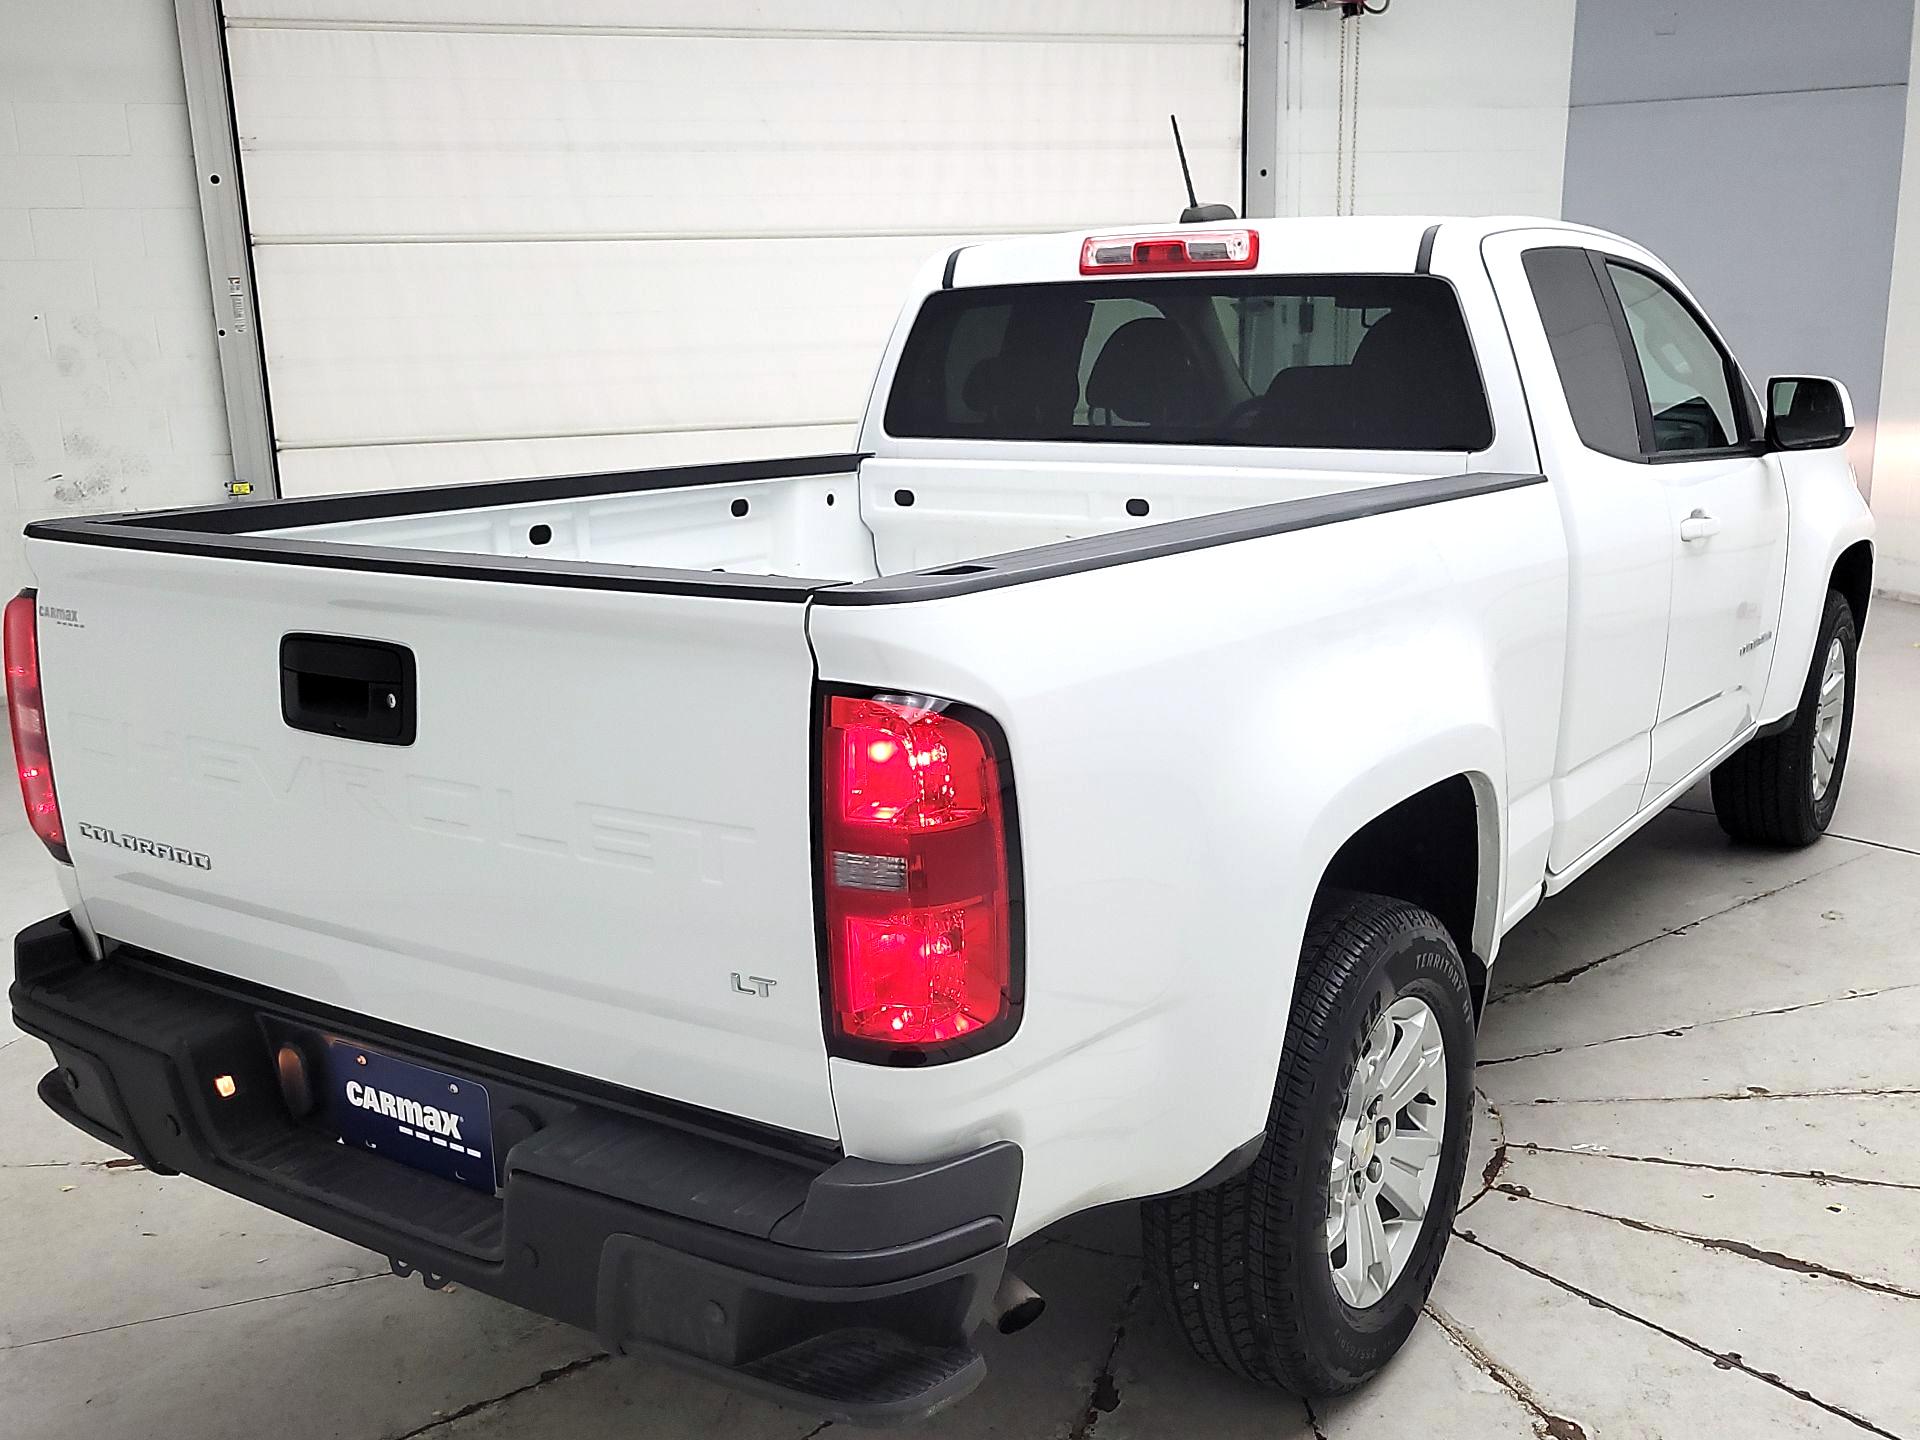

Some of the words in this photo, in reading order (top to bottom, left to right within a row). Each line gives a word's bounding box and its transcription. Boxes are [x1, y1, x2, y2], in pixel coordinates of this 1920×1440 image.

[68, 711, 757, 886] CHEVROLET
[78, 821, 212, 871] COLORADO
[730, 972, 778, 998] LT
[1415, 952, 1464, 993] TERRITORY
[345, 1080, 463, 1141] CARmax
